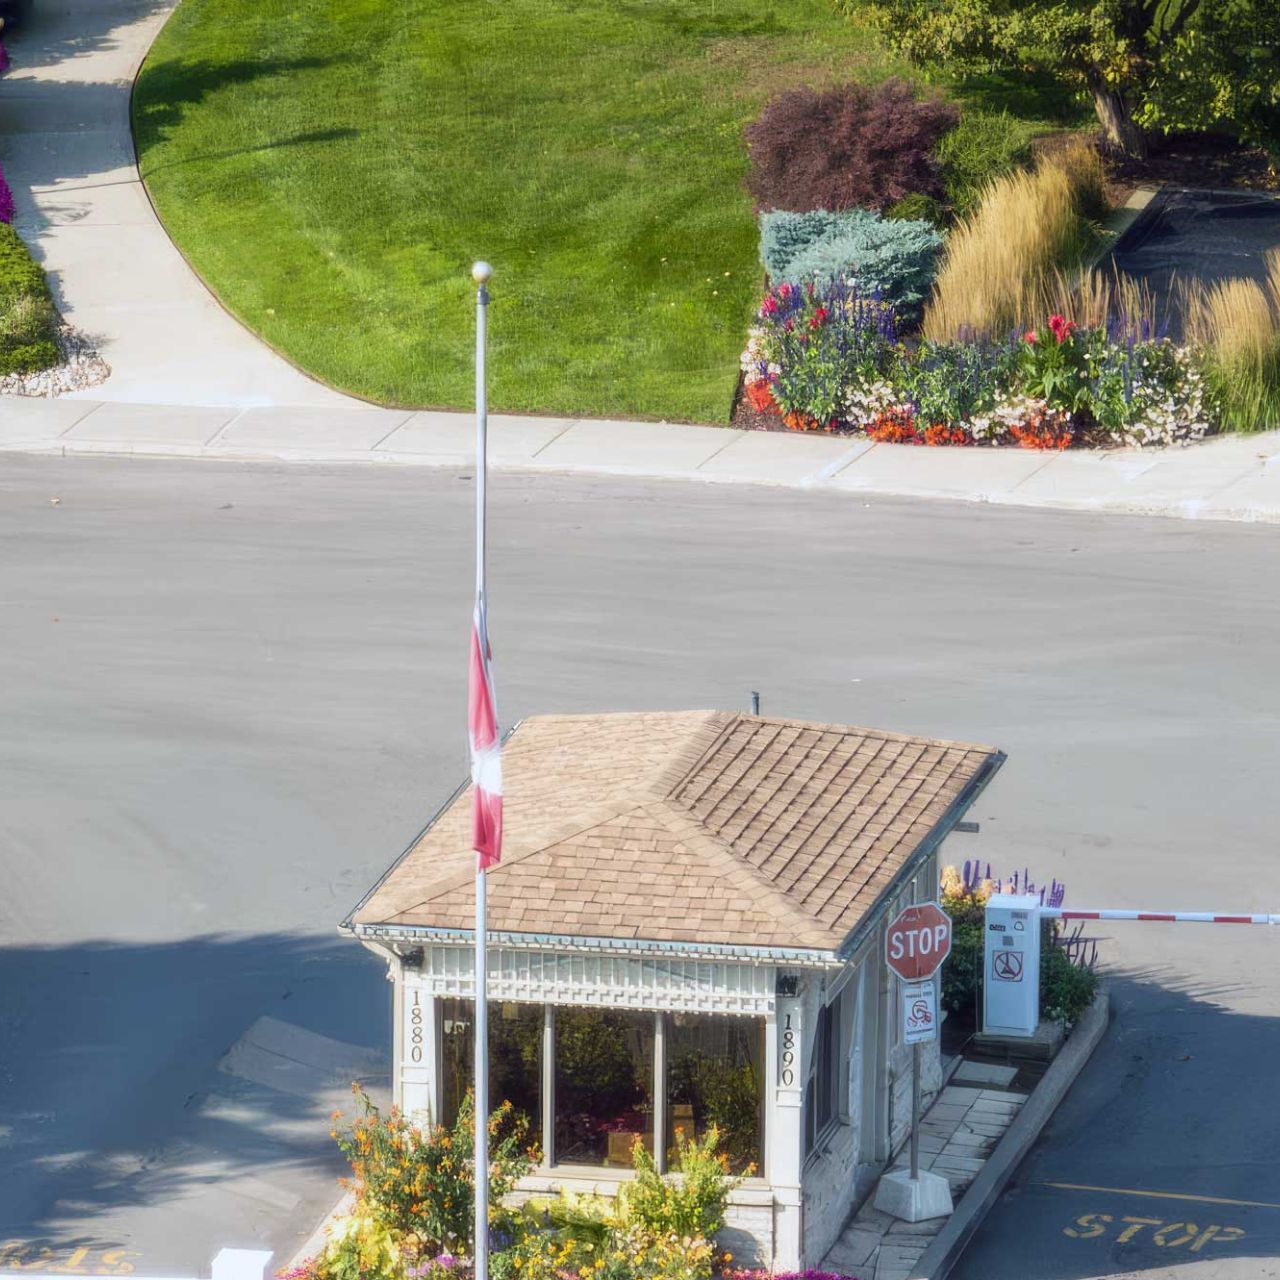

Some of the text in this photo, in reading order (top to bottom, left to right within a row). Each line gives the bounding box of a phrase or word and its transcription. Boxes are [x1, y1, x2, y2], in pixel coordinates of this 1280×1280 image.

[890, 924, 947, 960] STOP
[411, 990, 423, 1063] 1880
[782, 1013, 795, 1087] 1890
[1062, 1213, 1246, 1251] STOP
